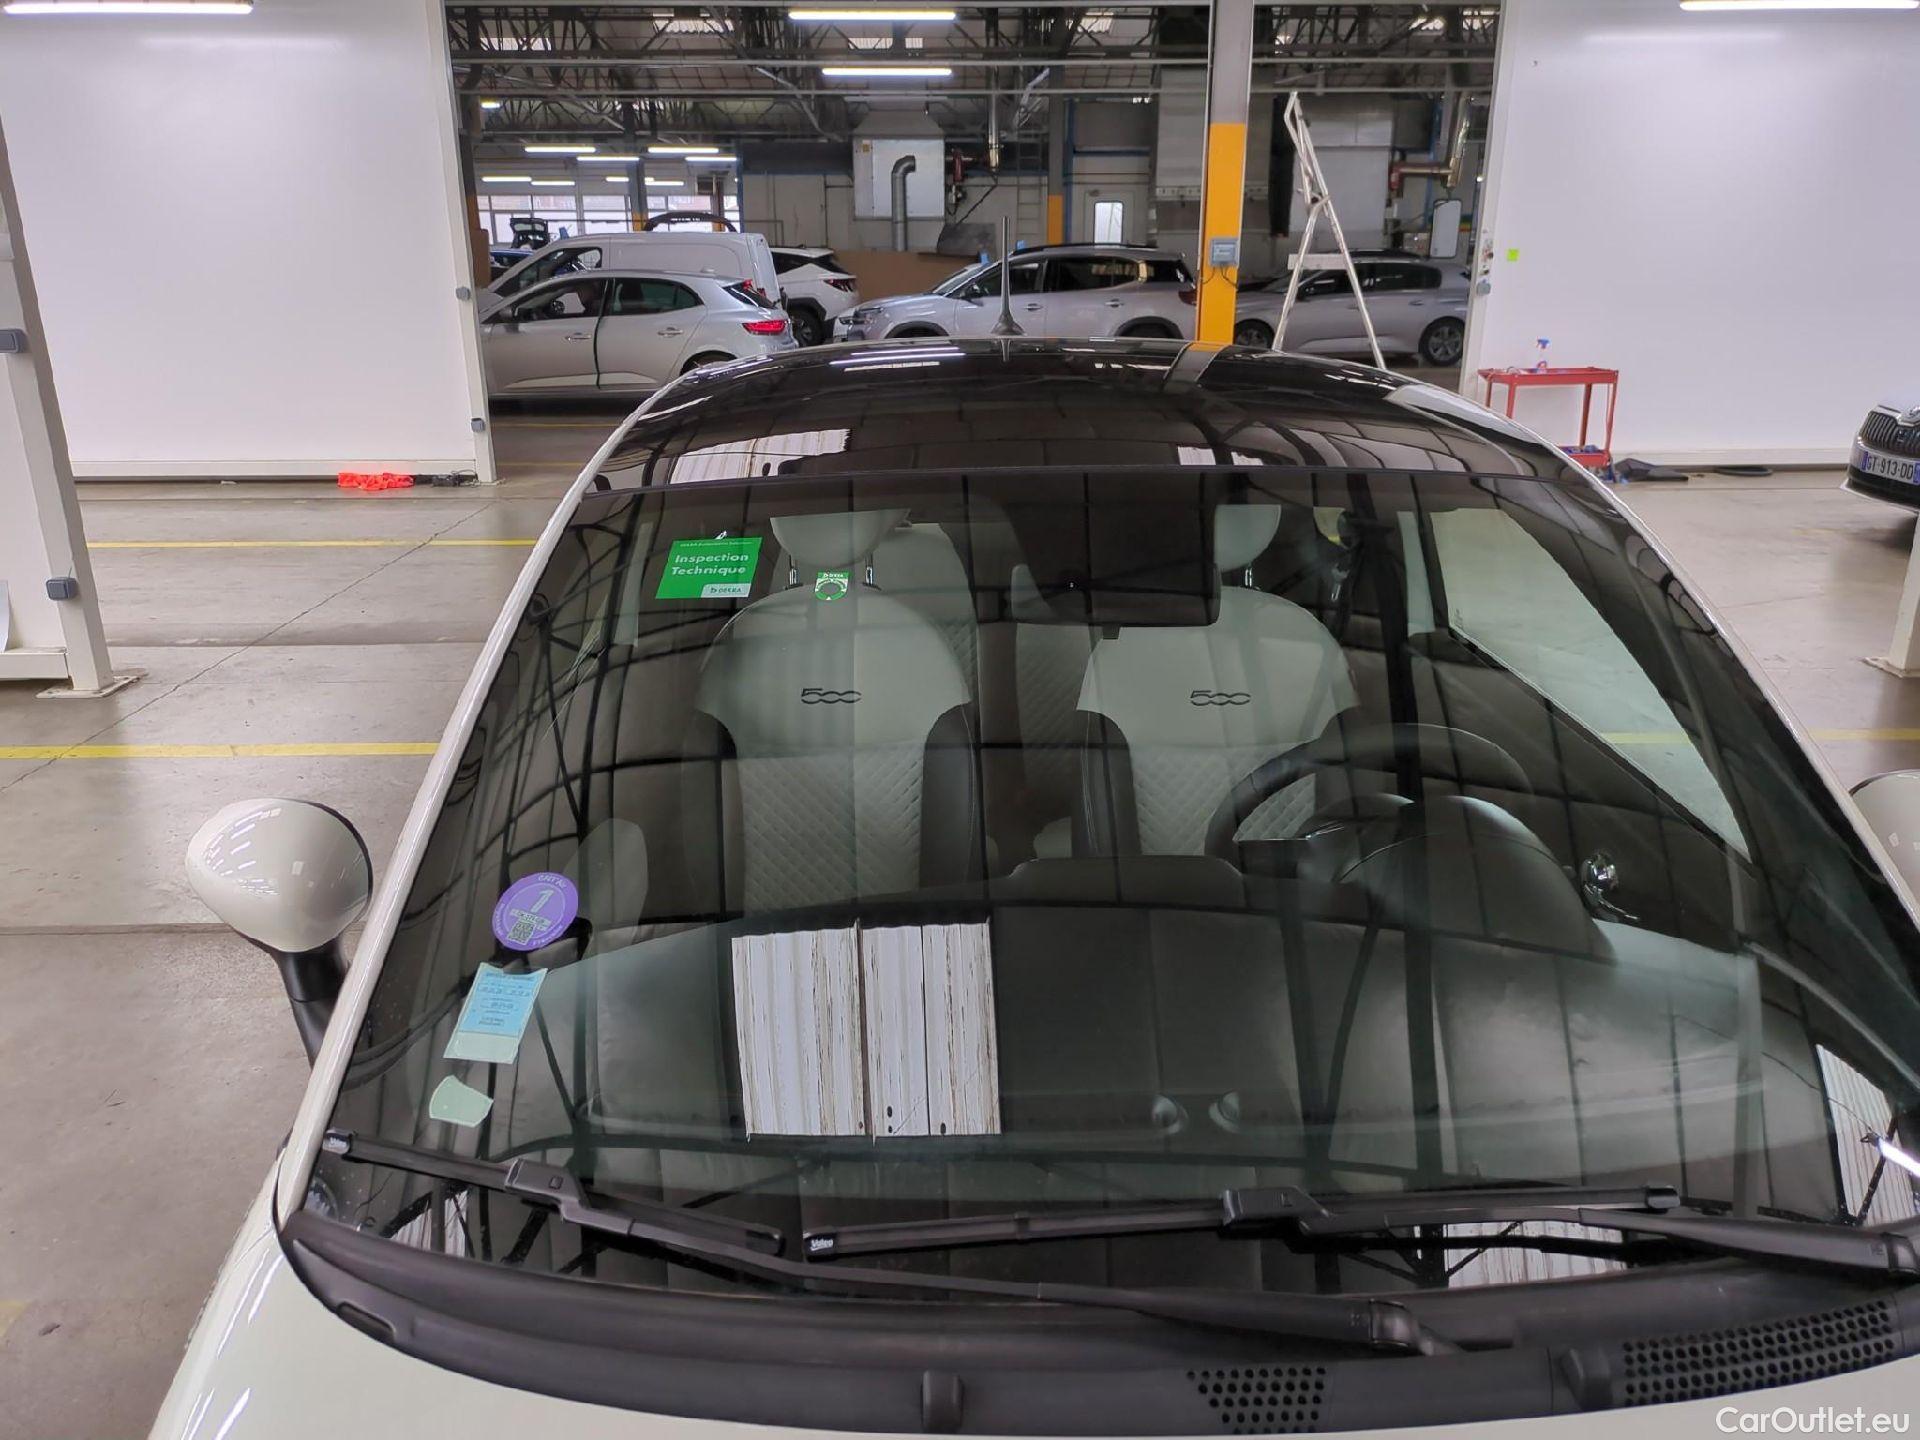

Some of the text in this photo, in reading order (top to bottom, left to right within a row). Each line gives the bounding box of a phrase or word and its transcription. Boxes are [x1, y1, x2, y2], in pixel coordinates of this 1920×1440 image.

[675, 552, 749, 564] Inspection
[671, 565, 747, 577] Technique
[801, 688, 862, 704] 500
[1190, 690, 1251, 706] 500
